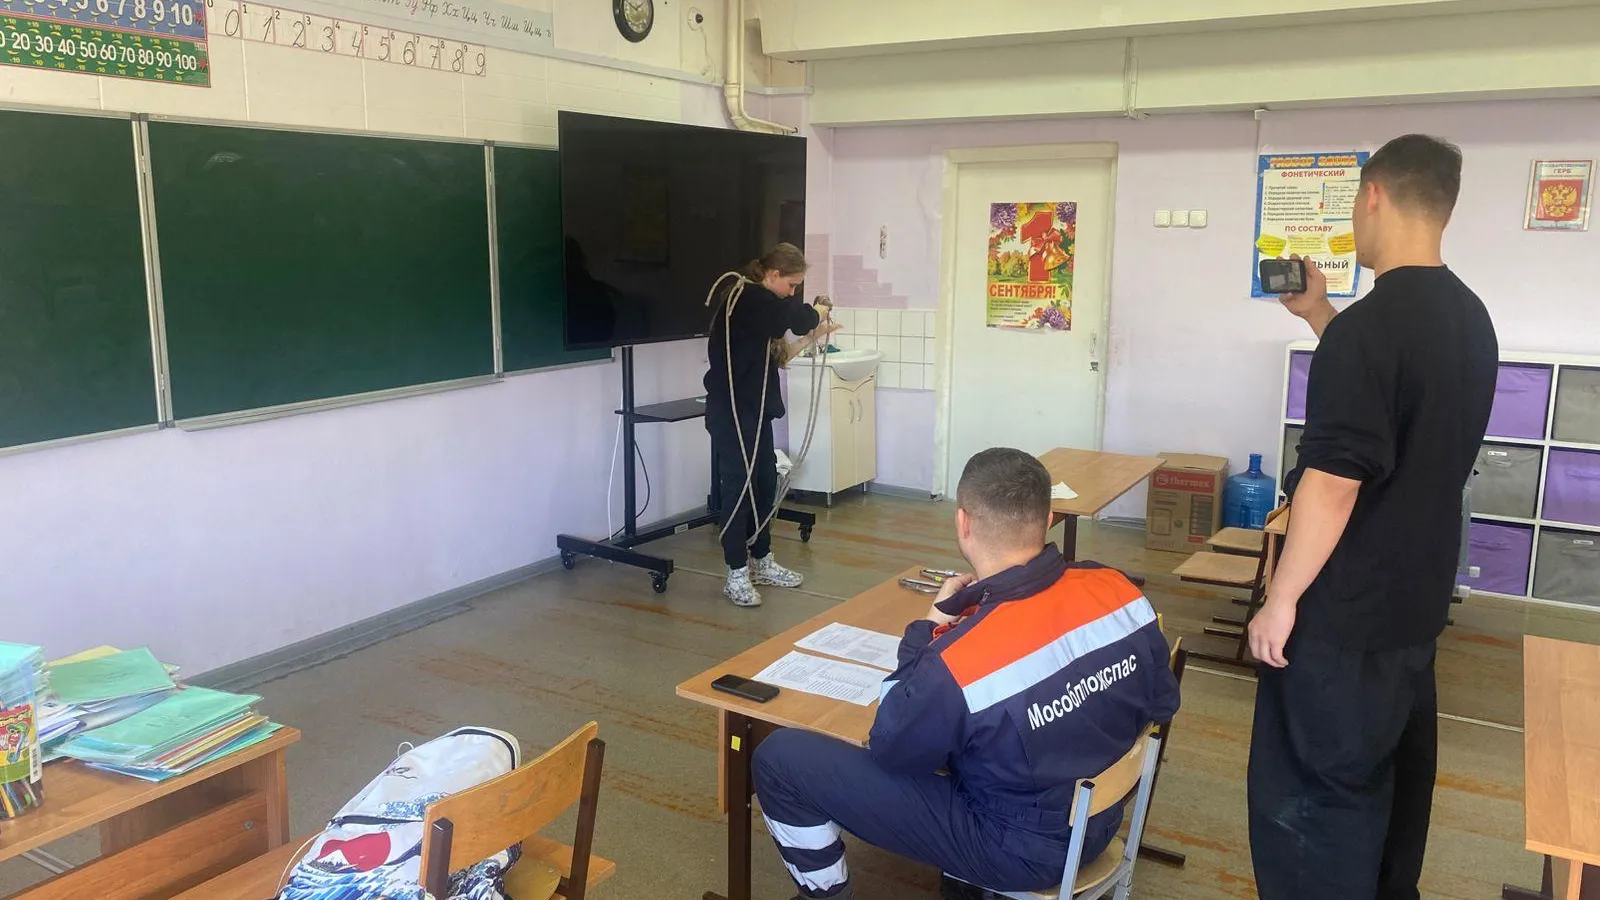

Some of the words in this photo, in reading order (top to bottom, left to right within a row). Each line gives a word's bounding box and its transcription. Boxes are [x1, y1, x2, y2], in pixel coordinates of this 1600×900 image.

[134, 0, 146, 19] 8
[152, 0, 165, 21] 9
[170, 2, 193, 26] 10
[243, 5, 248, 13] 1
[275, 10, 280, 19] 2
[306, 16, 311, 25] 3
[335, 20, 340, 29] 4
[364, 26, 368, 35] 5
[391, 32, 395, 40] 6
[11, 32, 30, 50] 20
[35, 35, 53, 53] 30
[58, 39, 75, 56] 40
[80, 41, 97, 58] 50
[100, 44, 116, 60] 60
[119, 46, 135, 63] 70
[138, 49, 154, 65] 80
[156, 51, 172, 68] 90
[175, 54, 197, 71] 100
[225, 9, 239, 36] 0
[263, 16, 273, 41] 1
[293, 21, 304, 48] 2
[322, 26, 333, 51] 3
[352, 31, 361, 57] 4
[378, 36, 389, 60] 5
[403, 41, 415, 64] 6
[429, 45, 439, 69] 7
[452, 49, 462, 72] 8
[475, 53, 485, 75] 9
[1281, 169, 1345, 178] ФОНЕТИЧЕСКИЙ
[1020, 211, 1054, 283] 1
[989, 284, 1056, 299] СЕНТЯБРЯ!
